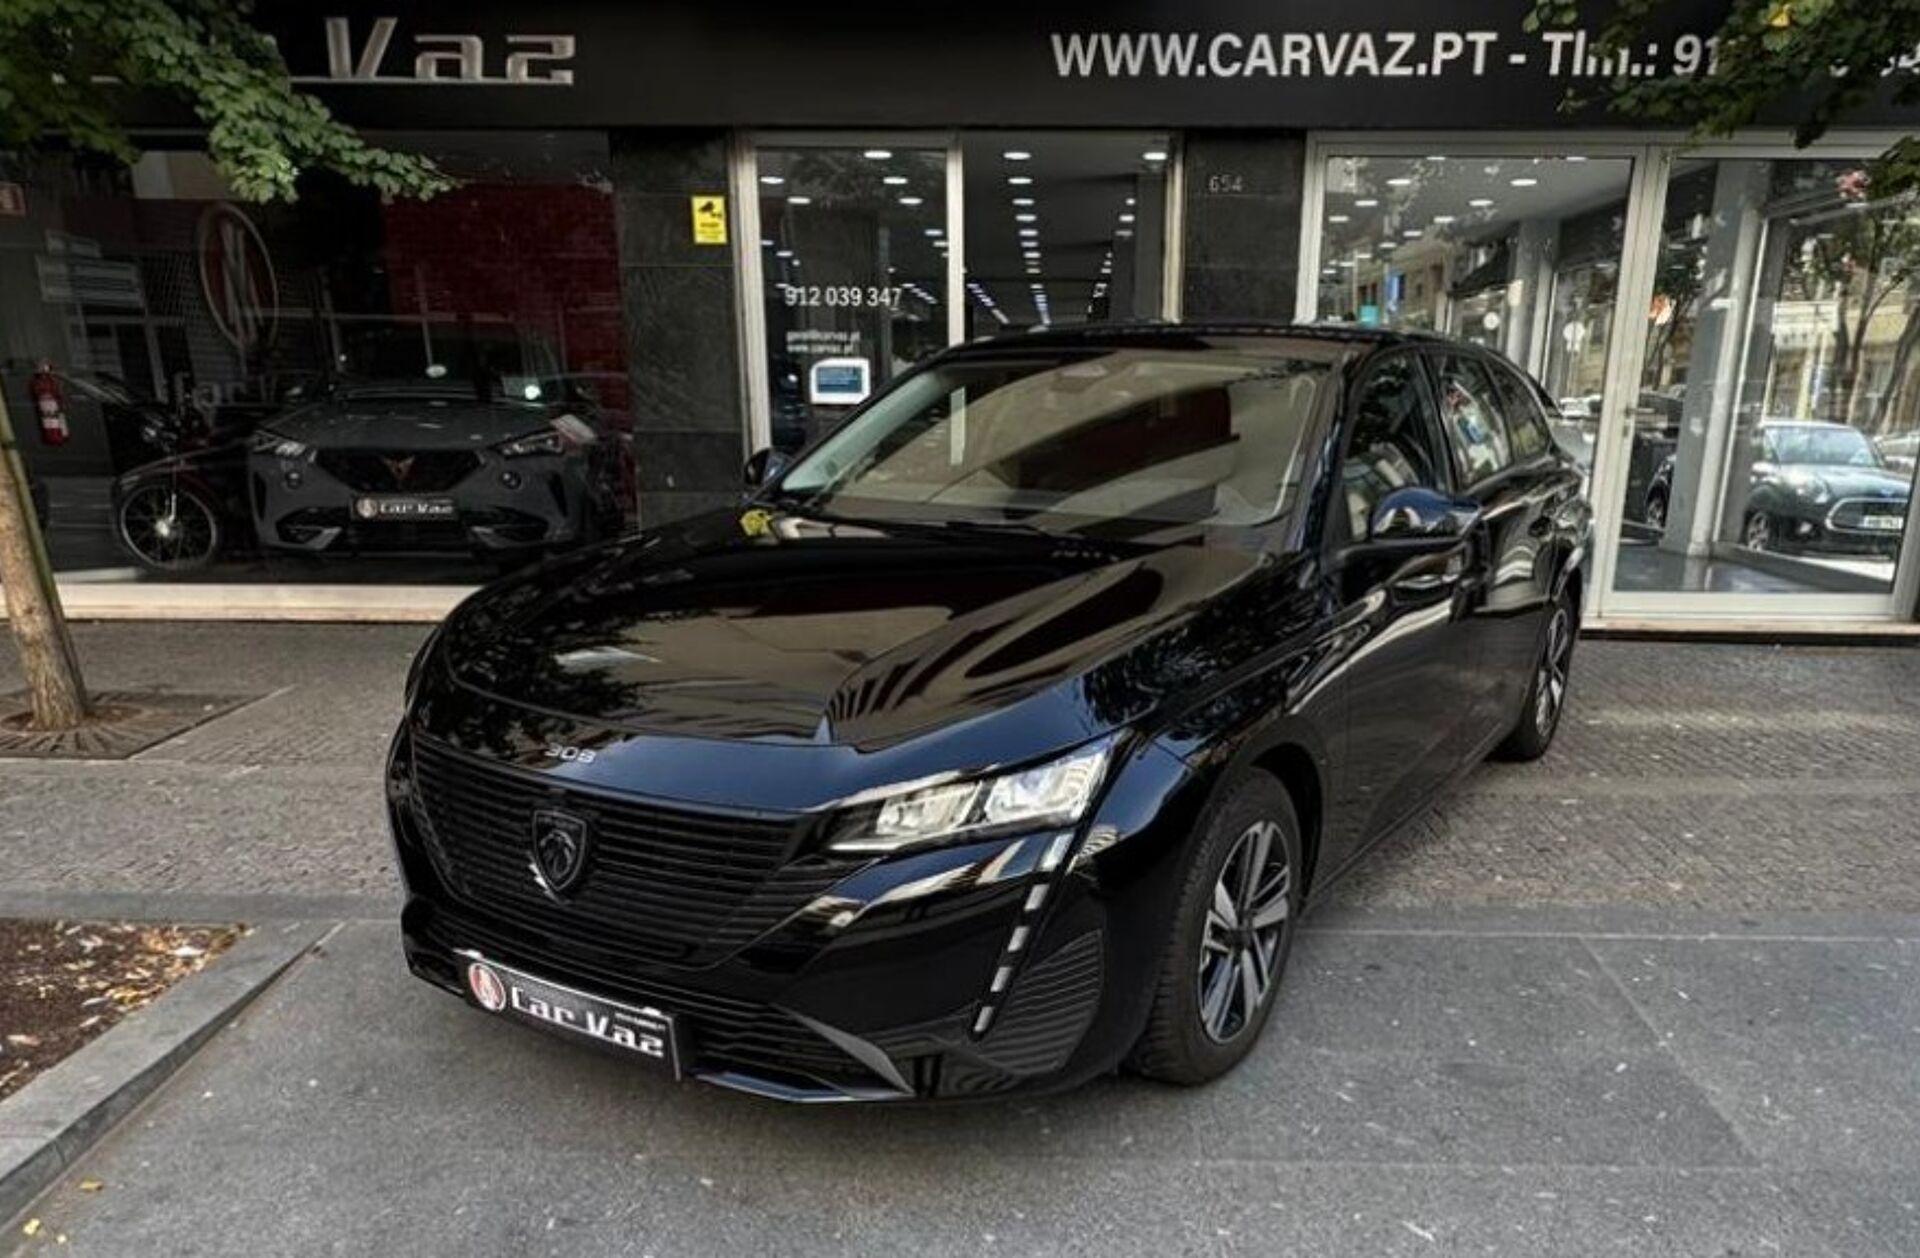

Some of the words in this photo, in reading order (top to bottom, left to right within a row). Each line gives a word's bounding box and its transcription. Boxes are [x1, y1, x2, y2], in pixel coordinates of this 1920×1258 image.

[325, 16, 575, 84] Vaz
[1051, 32, 1498, 77] WWW.CARVAZ.PT
[1541, 29, 1659, 76] Tlm.:
[785, 286, 821, 307] 912
[825, 286, 862, 307] 039
[866, 286, 902, 307] 347
[544, 742, 597, 763] 308
[511, 985, 576, 1026] Car
[585, 1010, 665, 1058] Vaz
